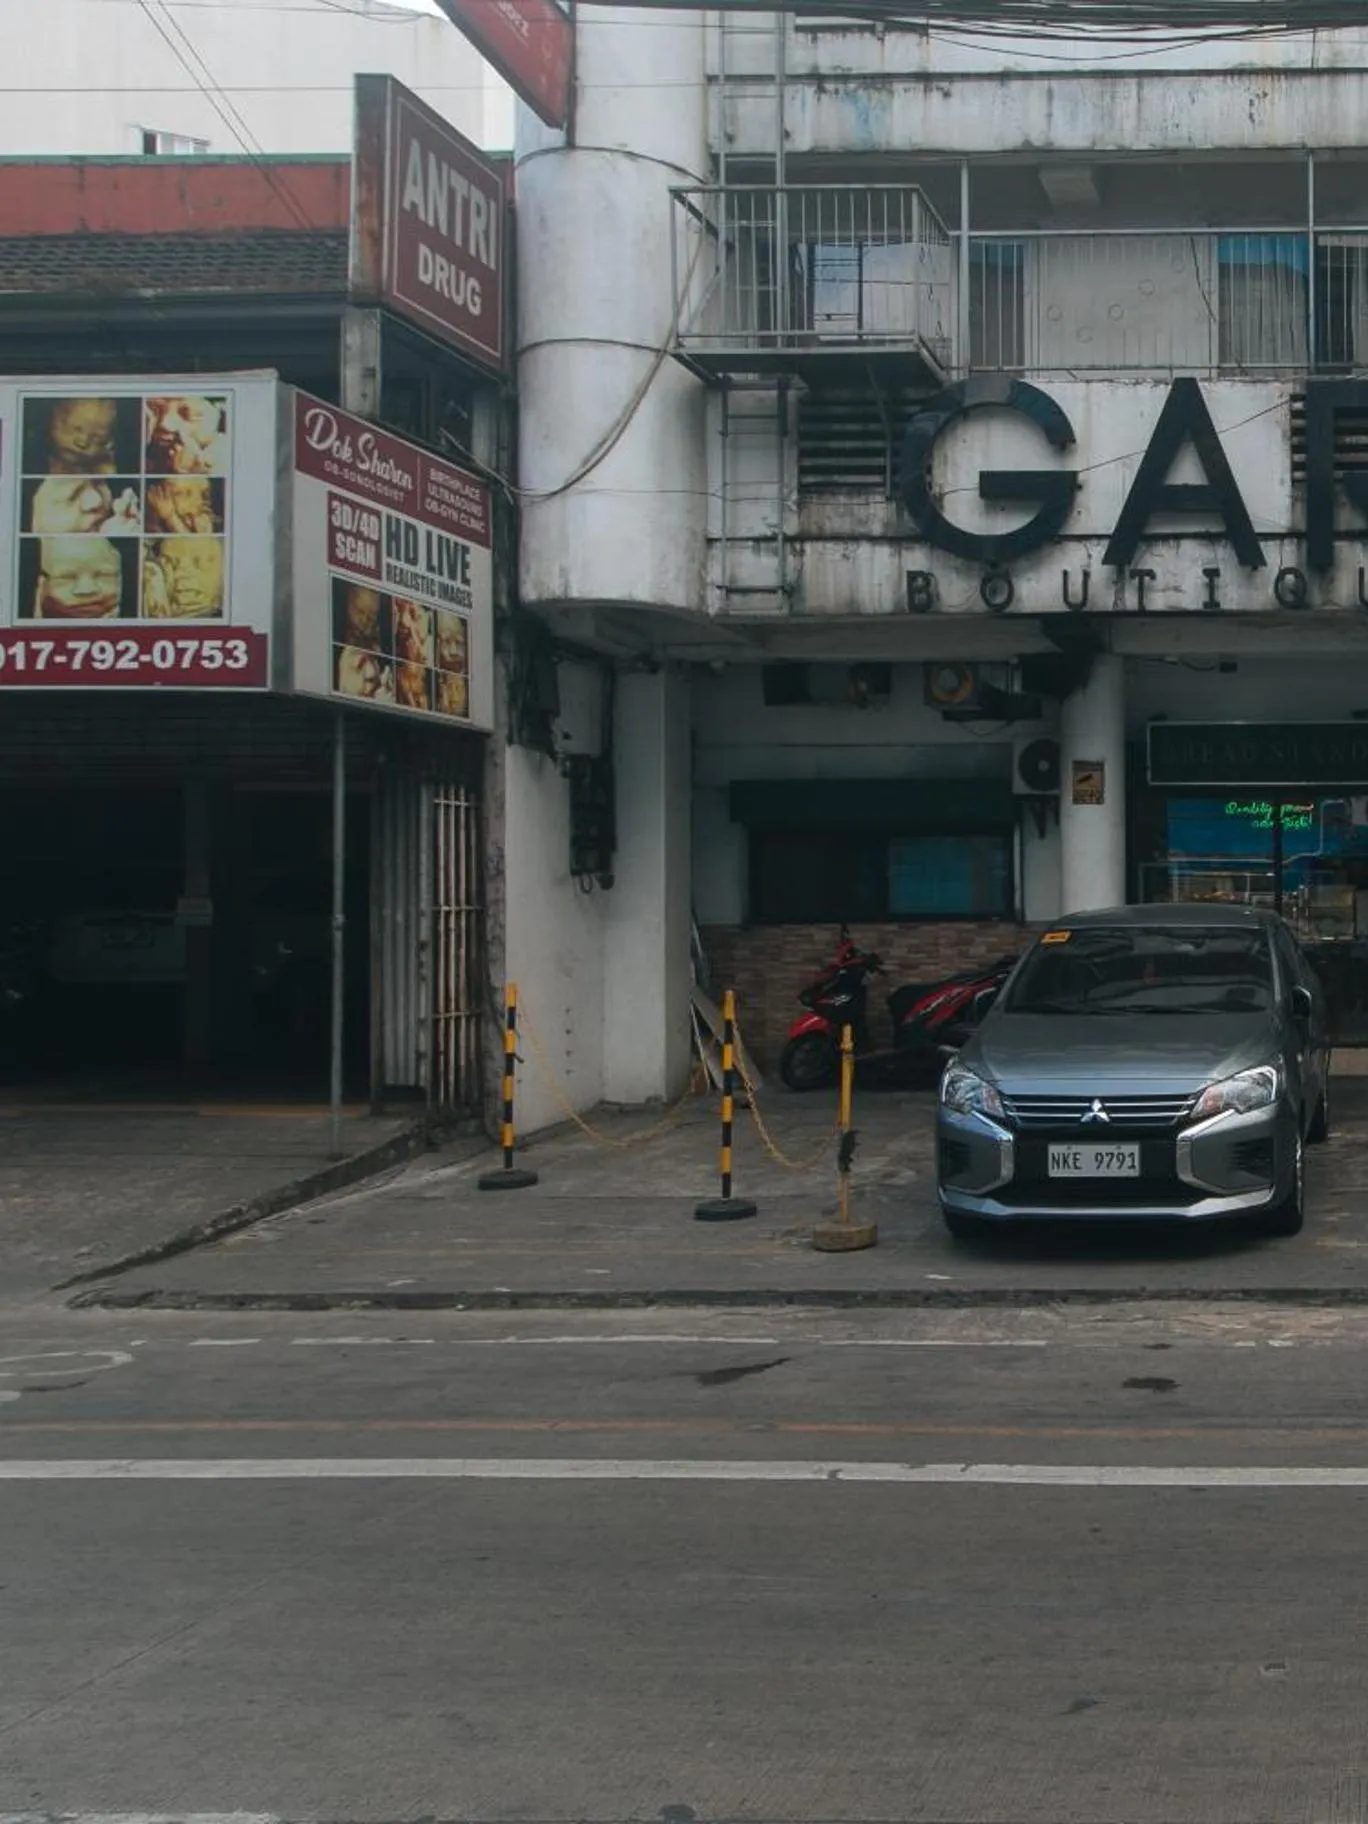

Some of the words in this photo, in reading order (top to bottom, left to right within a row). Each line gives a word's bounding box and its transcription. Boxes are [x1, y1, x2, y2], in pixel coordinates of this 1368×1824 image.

[402, 137, 496, 270] ANTRI
[418, 242, 482, 316] DRUG
[305, 408, 353, 463] Dok
[355, 432, 413, 491] Sharon
[331, 500, 380, 541] 3D/4D
[335, 532, 377, 570] SCAN
[386, 512, 419, 567] HD
[425, 528, 472, 586] LIVE
[386, 561, 437, 598] REALISTIC
[438, 579, 473, 610] IMAGES
[0, 639, 248, 671] 17-792-0753
[1051, 1151, 1083, 1171] NKE
[1094, 1151, 1137, 1171] 9791
